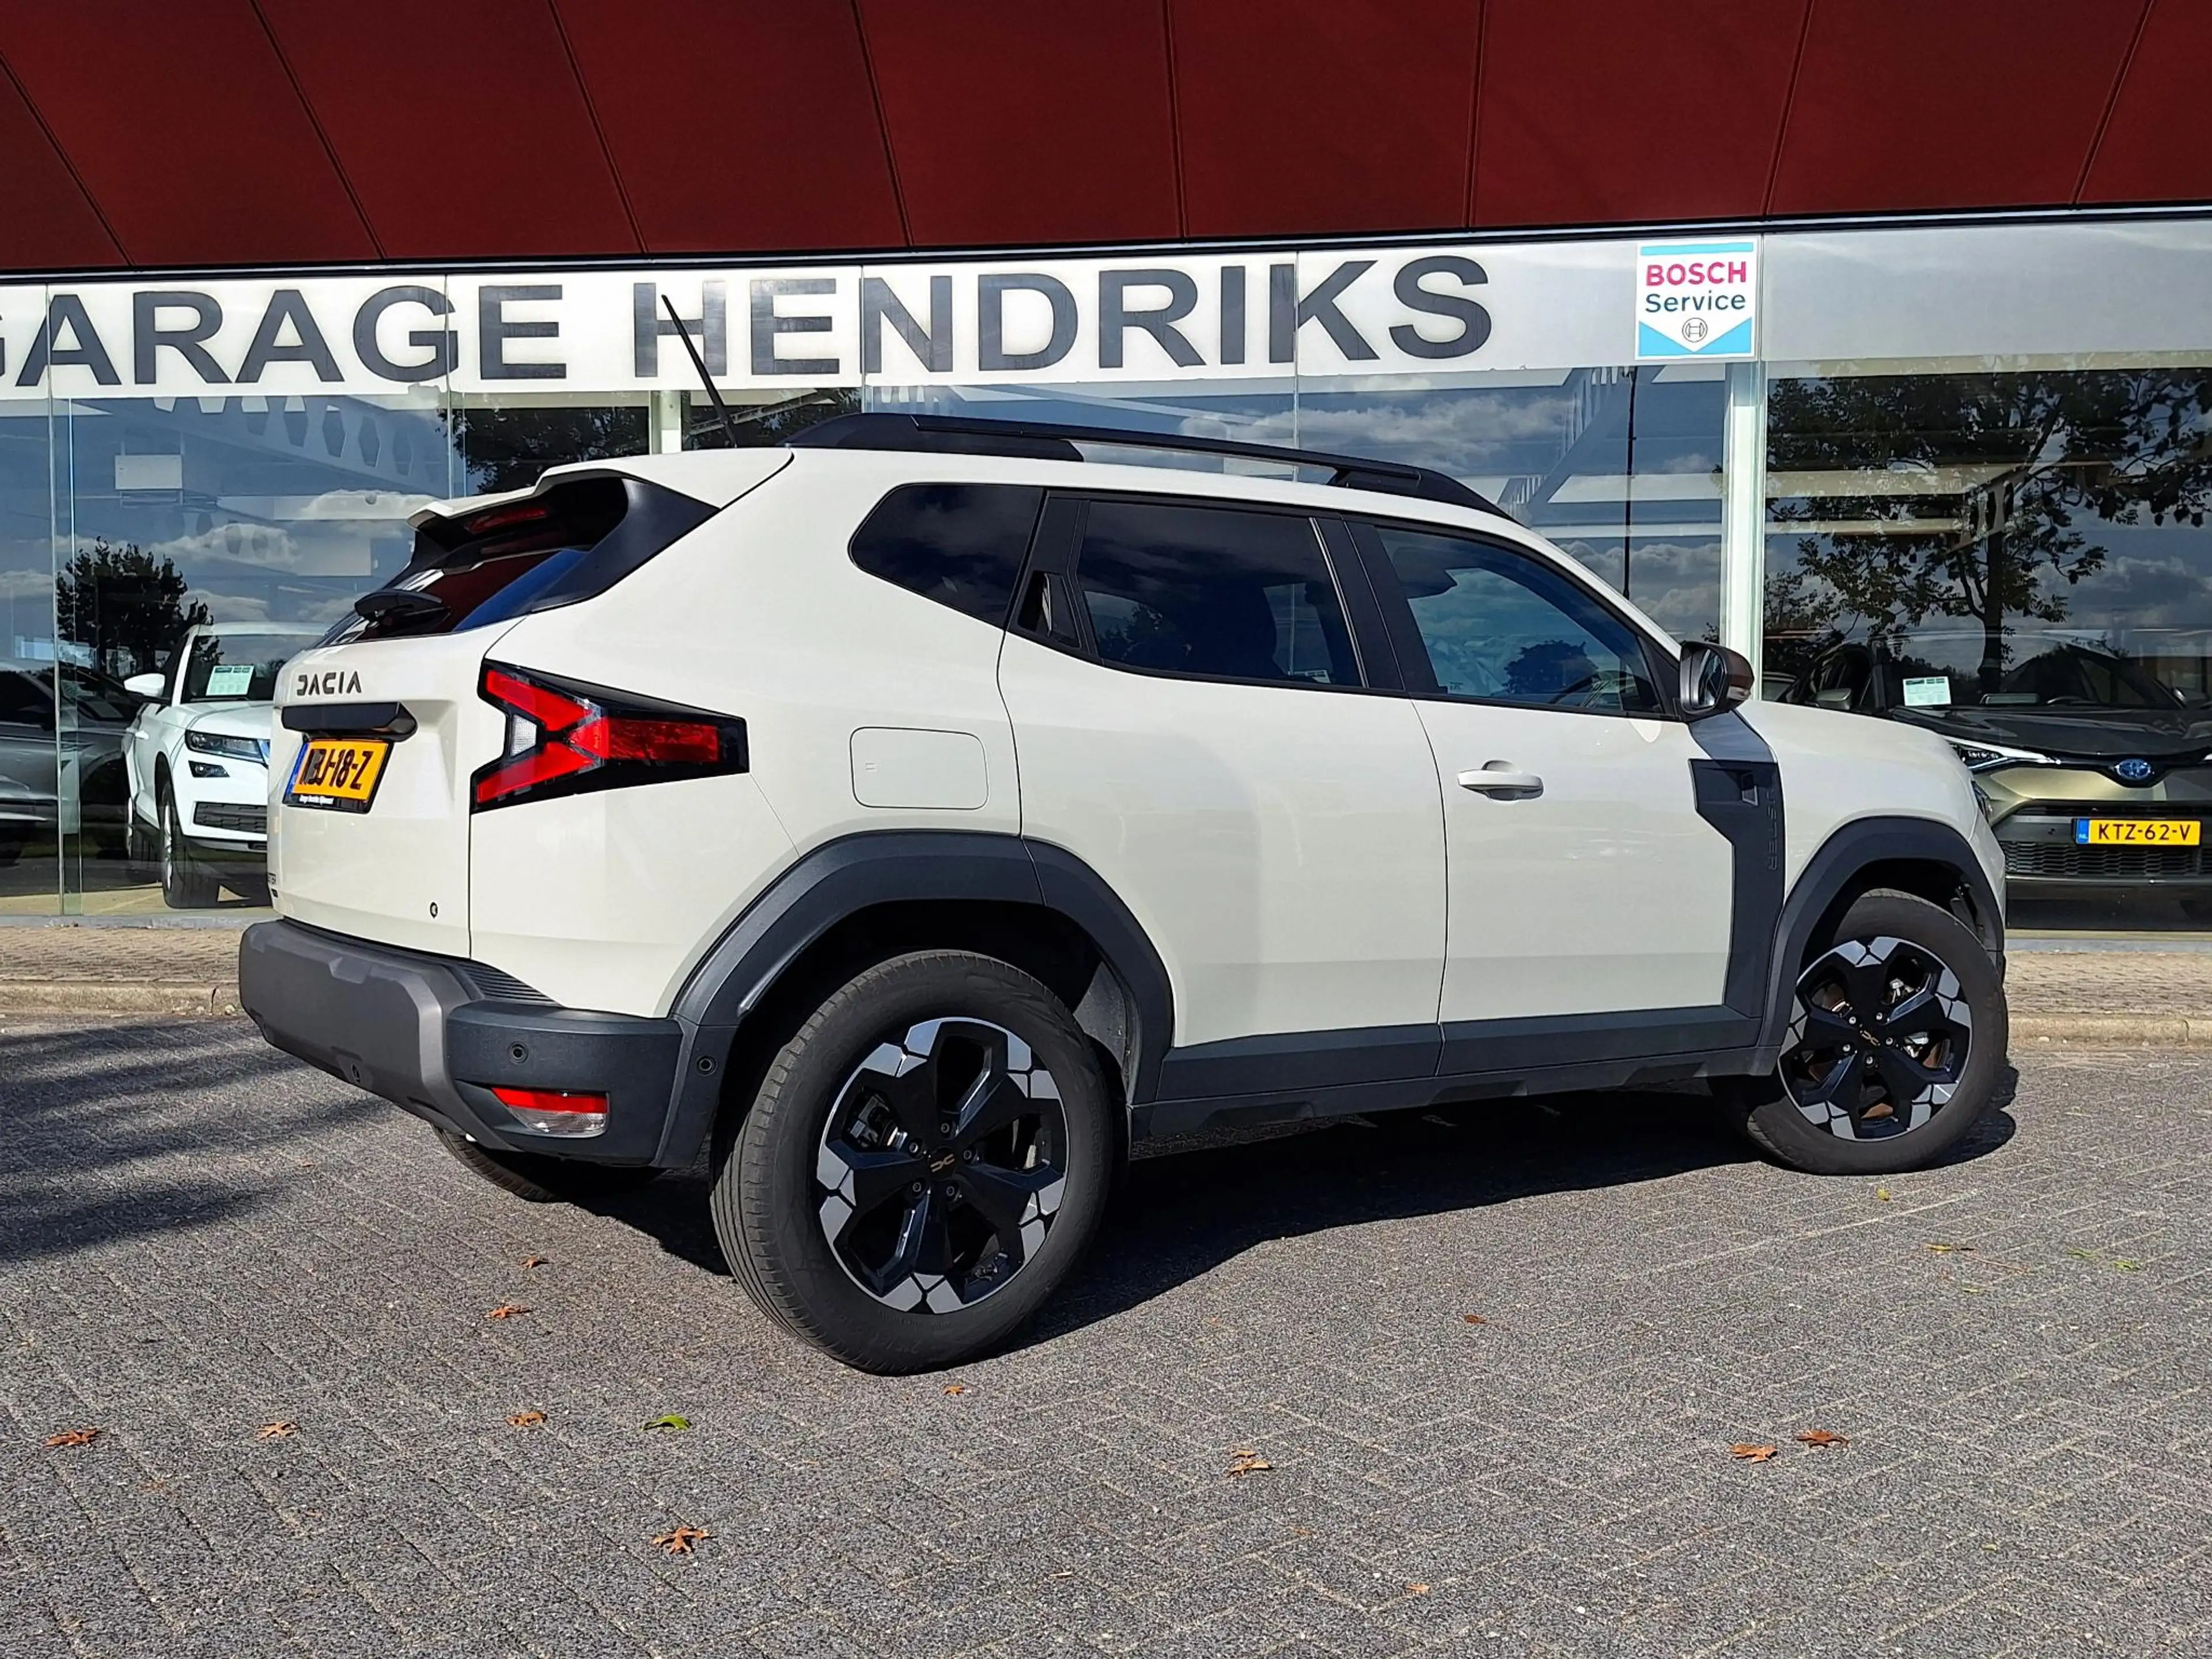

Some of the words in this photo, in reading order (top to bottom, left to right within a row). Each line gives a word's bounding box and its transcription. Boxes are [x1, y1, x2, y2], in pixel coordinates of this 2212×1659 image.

[1646, 261, 1747, 287] BOSCH
[1645, 290, 1746, 313] Service
[0, 285, 567, 387] ARAGE
[633, 255, 1492, 377] HENDRIKS
[297, 671, 362, 696] DACIA
[1766, 781, 1778, 871] USTER
[2099, 823, 2191, 841] KTZ-62-V
